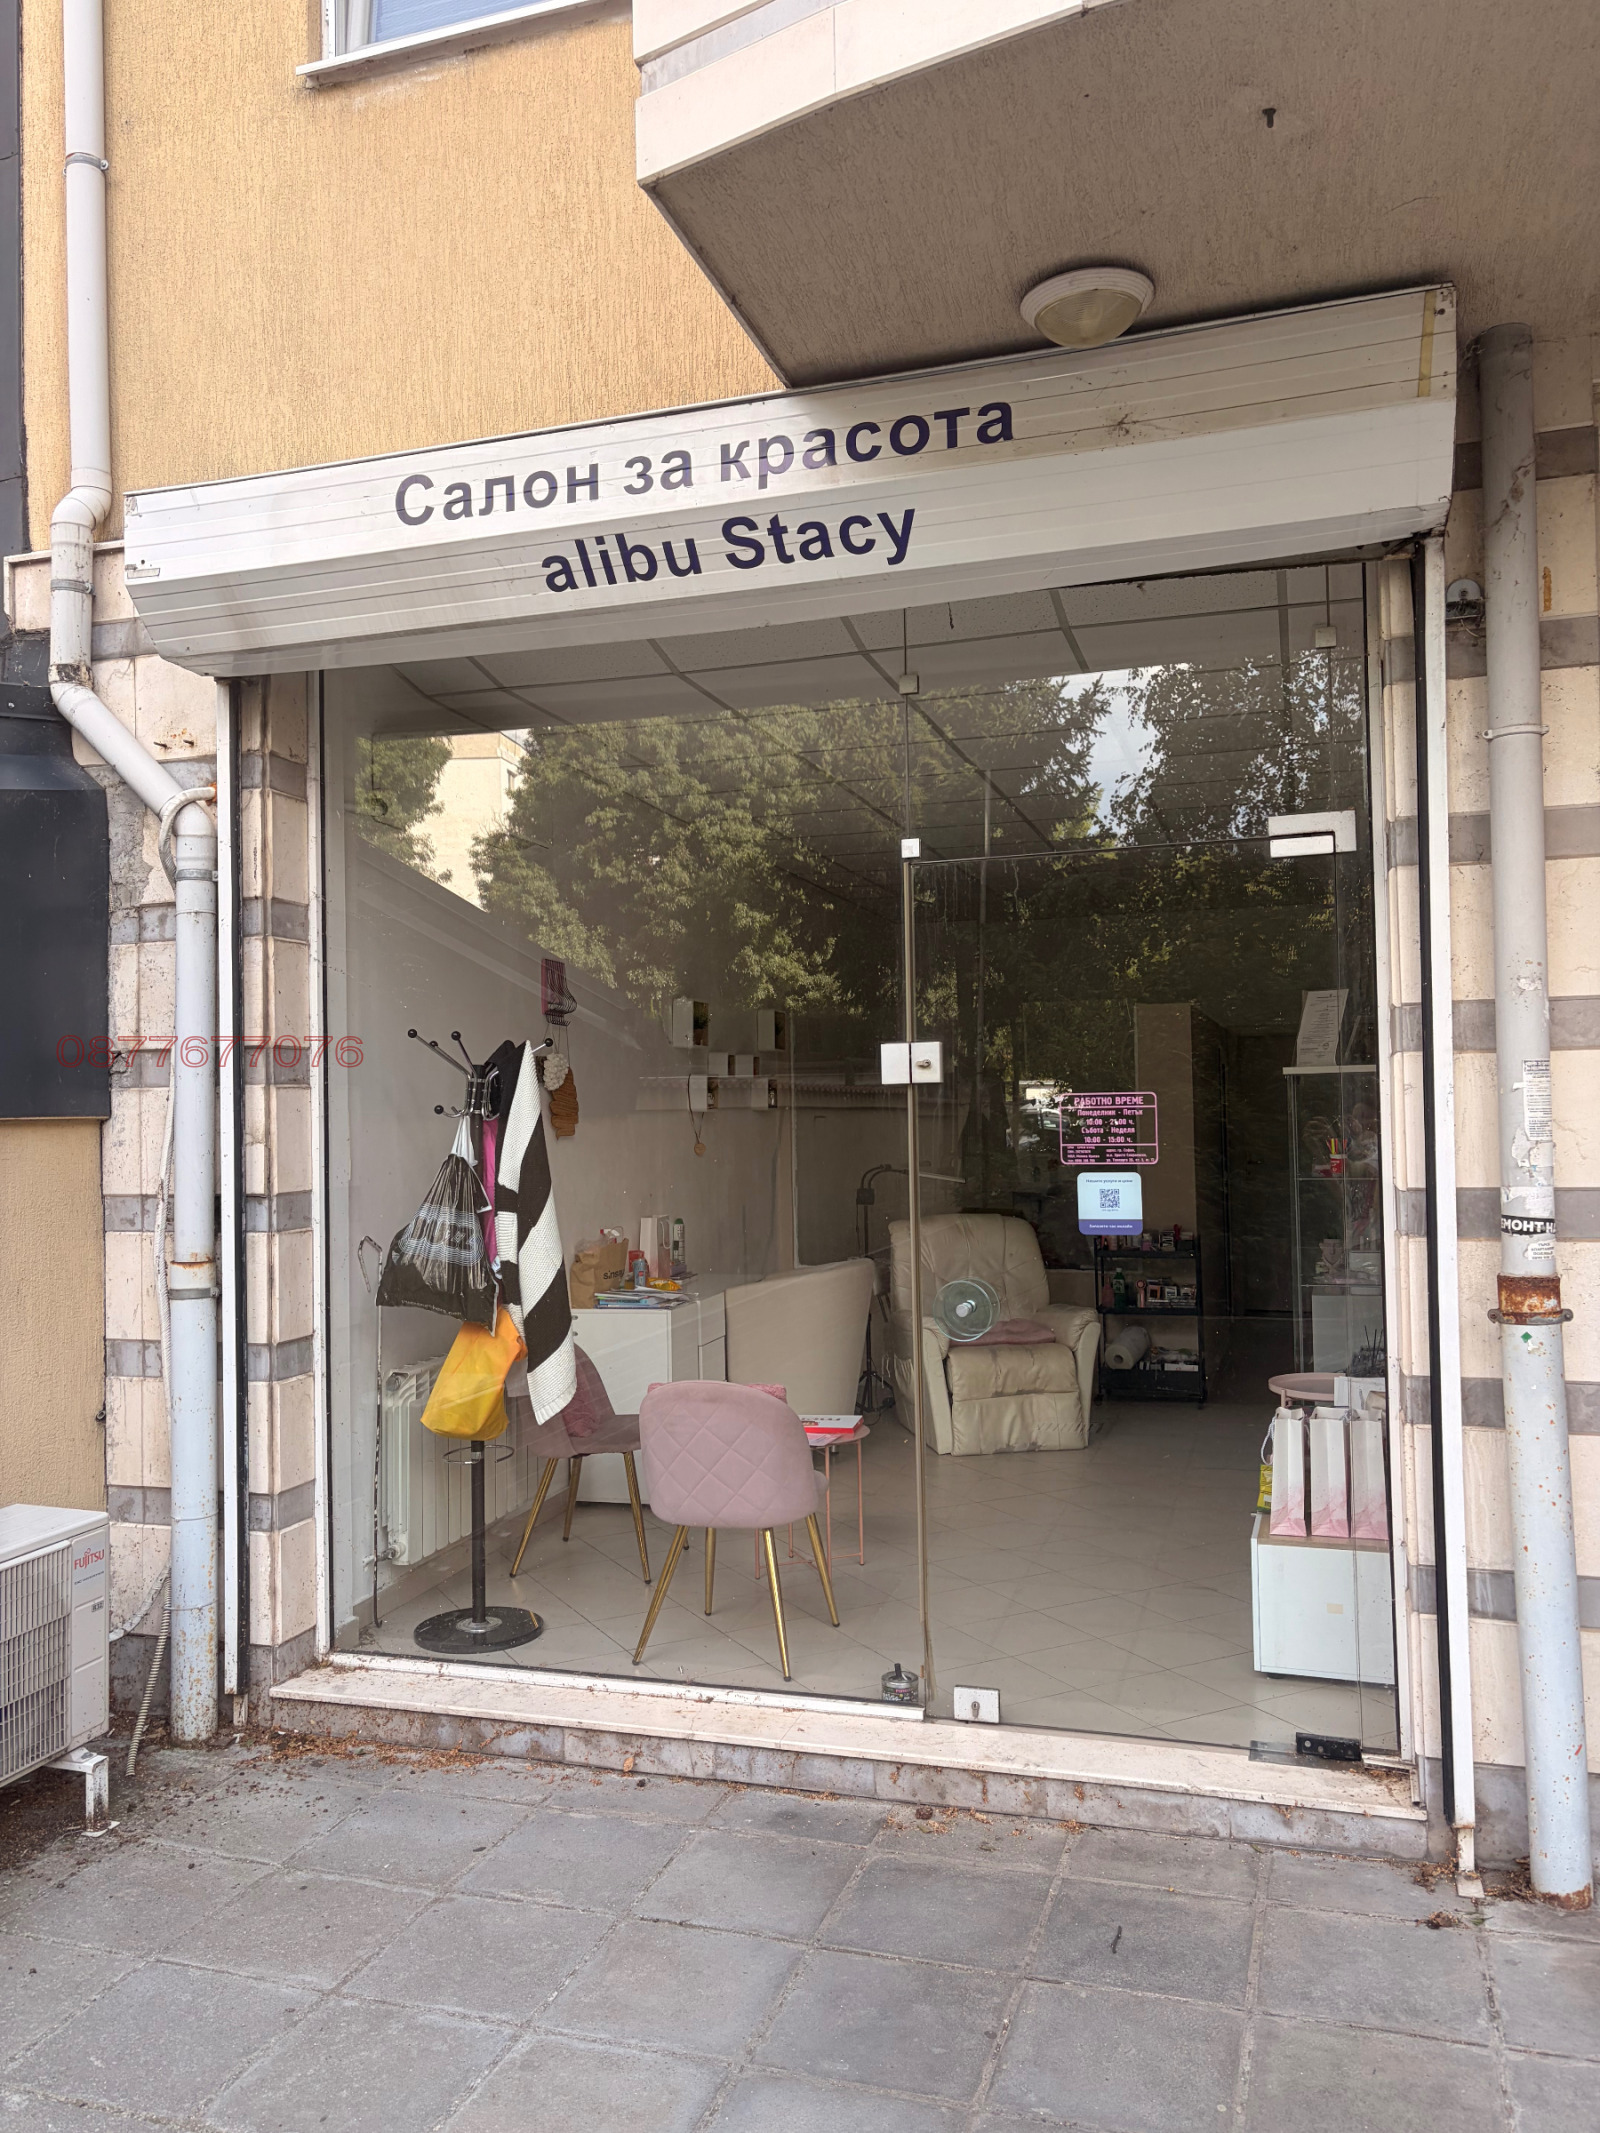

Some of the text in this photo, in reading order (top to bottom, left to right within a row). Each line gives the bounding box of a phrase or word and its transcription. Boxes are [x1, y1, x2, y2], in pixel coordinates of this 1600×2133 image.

[395, 401, 1015, 525] Салон за красота
[541, 508, 916, 593] alibu Stacy
[1074, 1096, 1144, 1106] РАБОТНО ВРЕМЕ
[1077, 1109, 1116, 1117] Понеделник
[1123, 1108, 1143, 1116] Петък
[74, 1547, 105, 1570] FUJITSU
